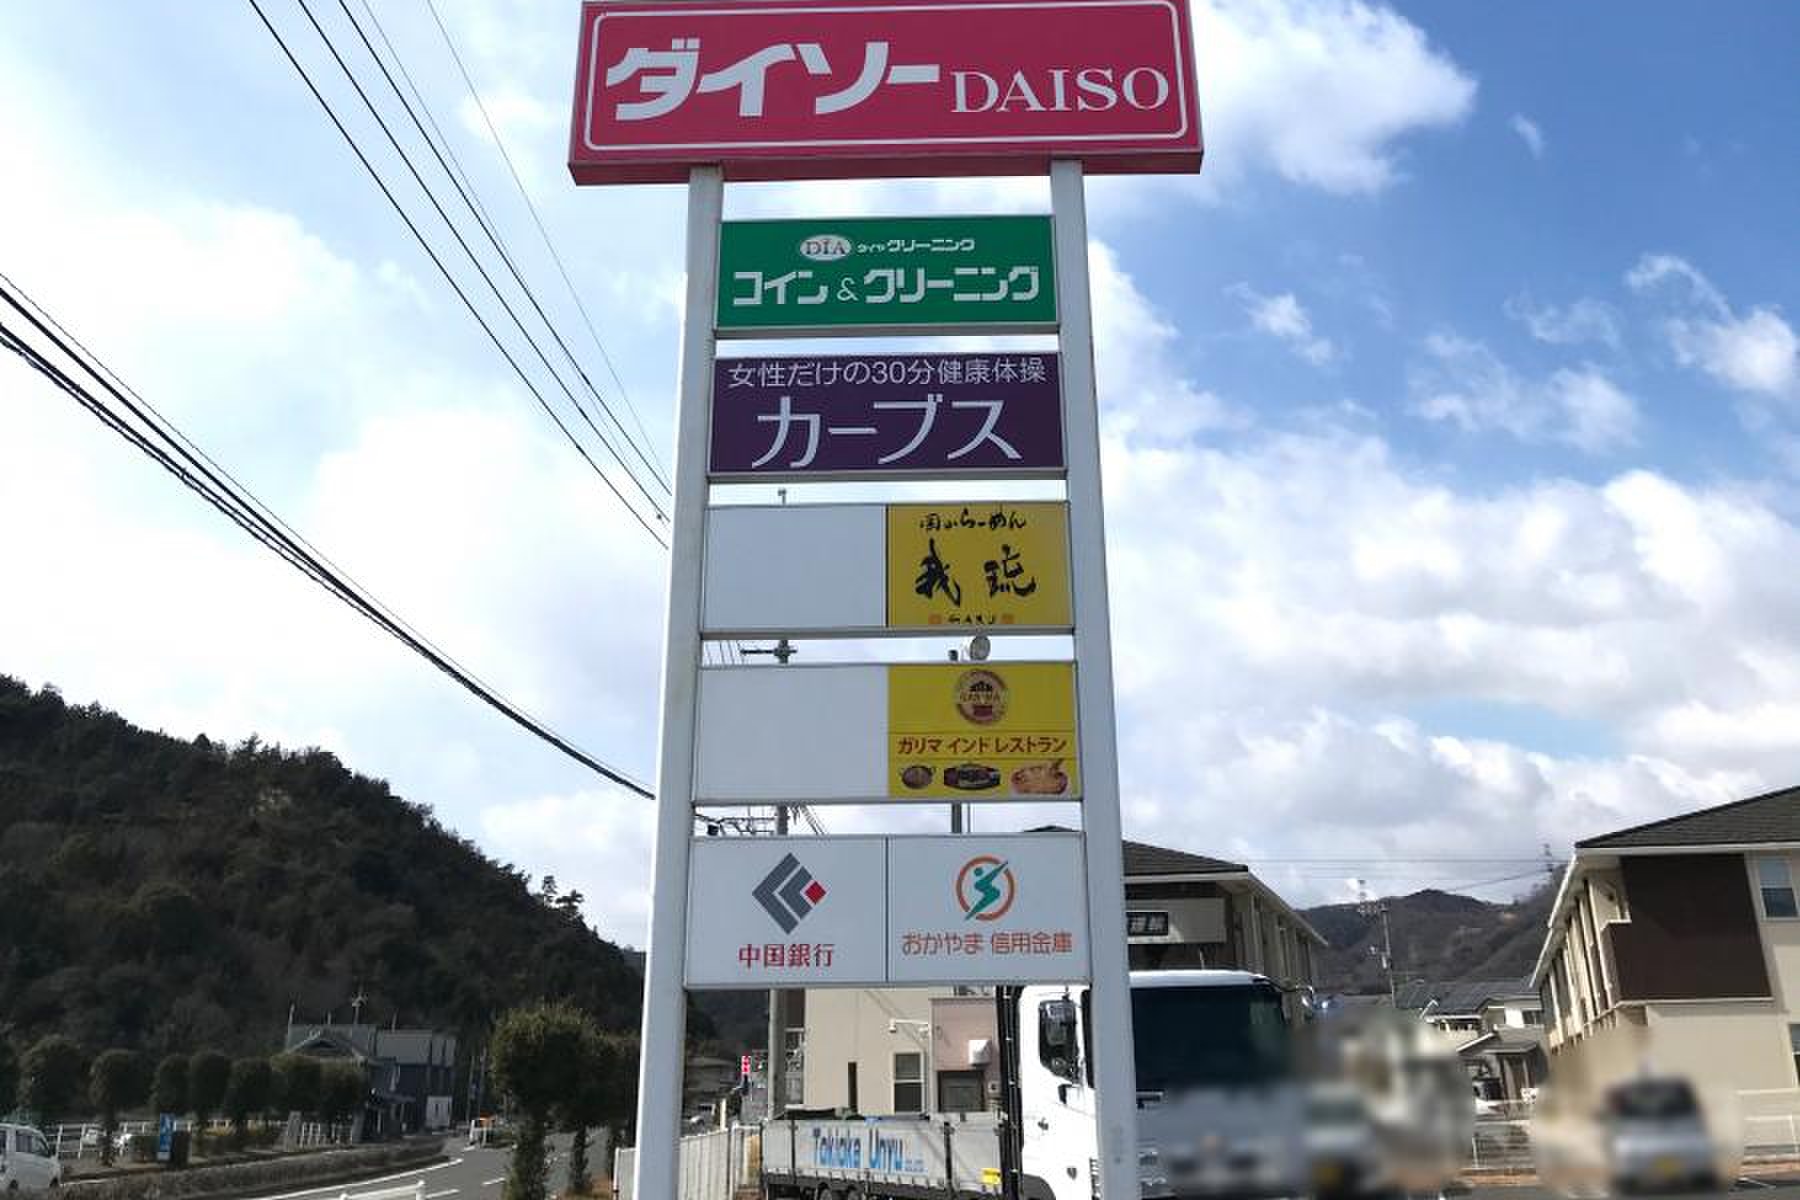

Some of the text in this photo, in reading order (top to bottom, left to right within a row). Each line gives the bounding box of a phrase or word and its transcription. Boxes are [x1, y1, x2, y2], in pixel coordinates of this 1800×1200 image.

[606, 38, 939, 121] ダイソー
[950, 66, 1170, 114] DAISO
[805, 239, 846, 255] DIA
[728, 357, 1047, 388] 女性だけの30分健康体操
[751, 393, 1023, 469] カーブス
[738, 943, 835, 968] 中国銀行
